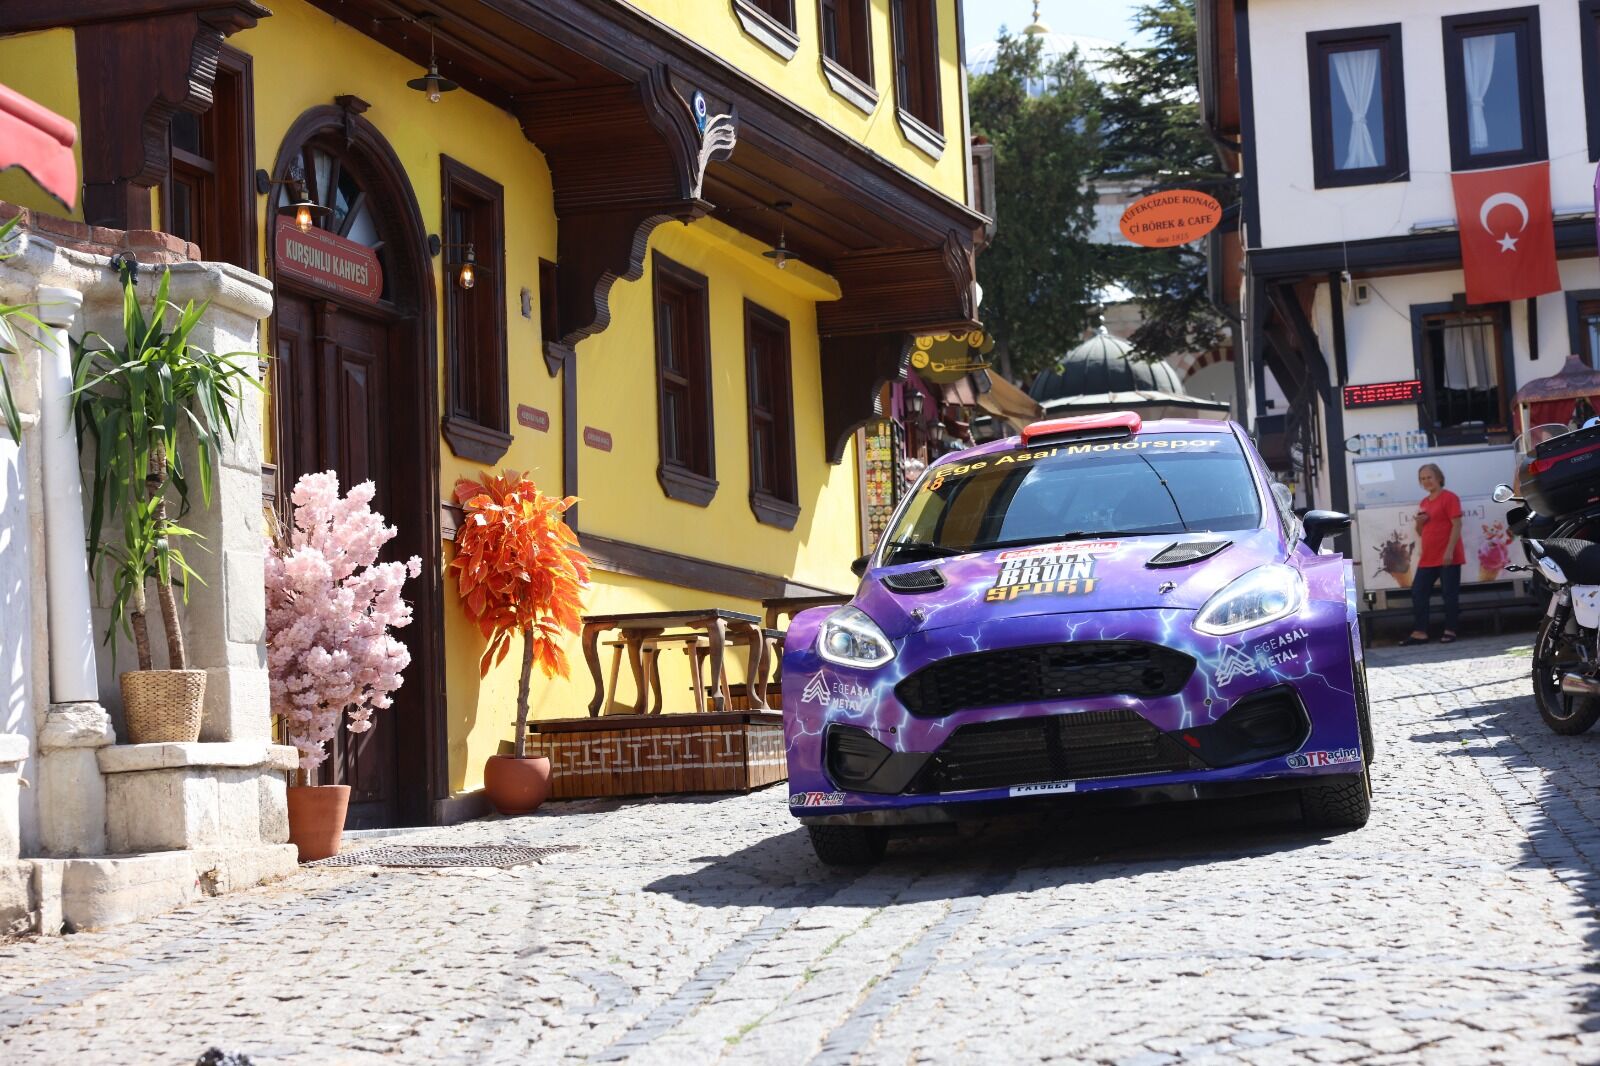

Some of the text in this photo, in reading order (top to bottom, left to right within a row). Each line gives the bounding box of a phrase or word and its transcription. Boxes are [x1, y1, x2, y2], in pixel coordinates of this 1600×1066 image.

[1142, 219, 1175, 232] BÖREK
[1177, 218, 1185, 228] &
[1187, 214, 1213, 226] CAFE
[286, 239, 331, 273] KURŞUNLU
[332, 255, 369, 286] KAHVESİ
[935, 438, 1221, 479] Ege Asal Motorspor
[998, 561, 1094, 588] BRUIN
[985, 578, 1097, 601] SPORT
[1259, 648, 1298, 671] METAL
